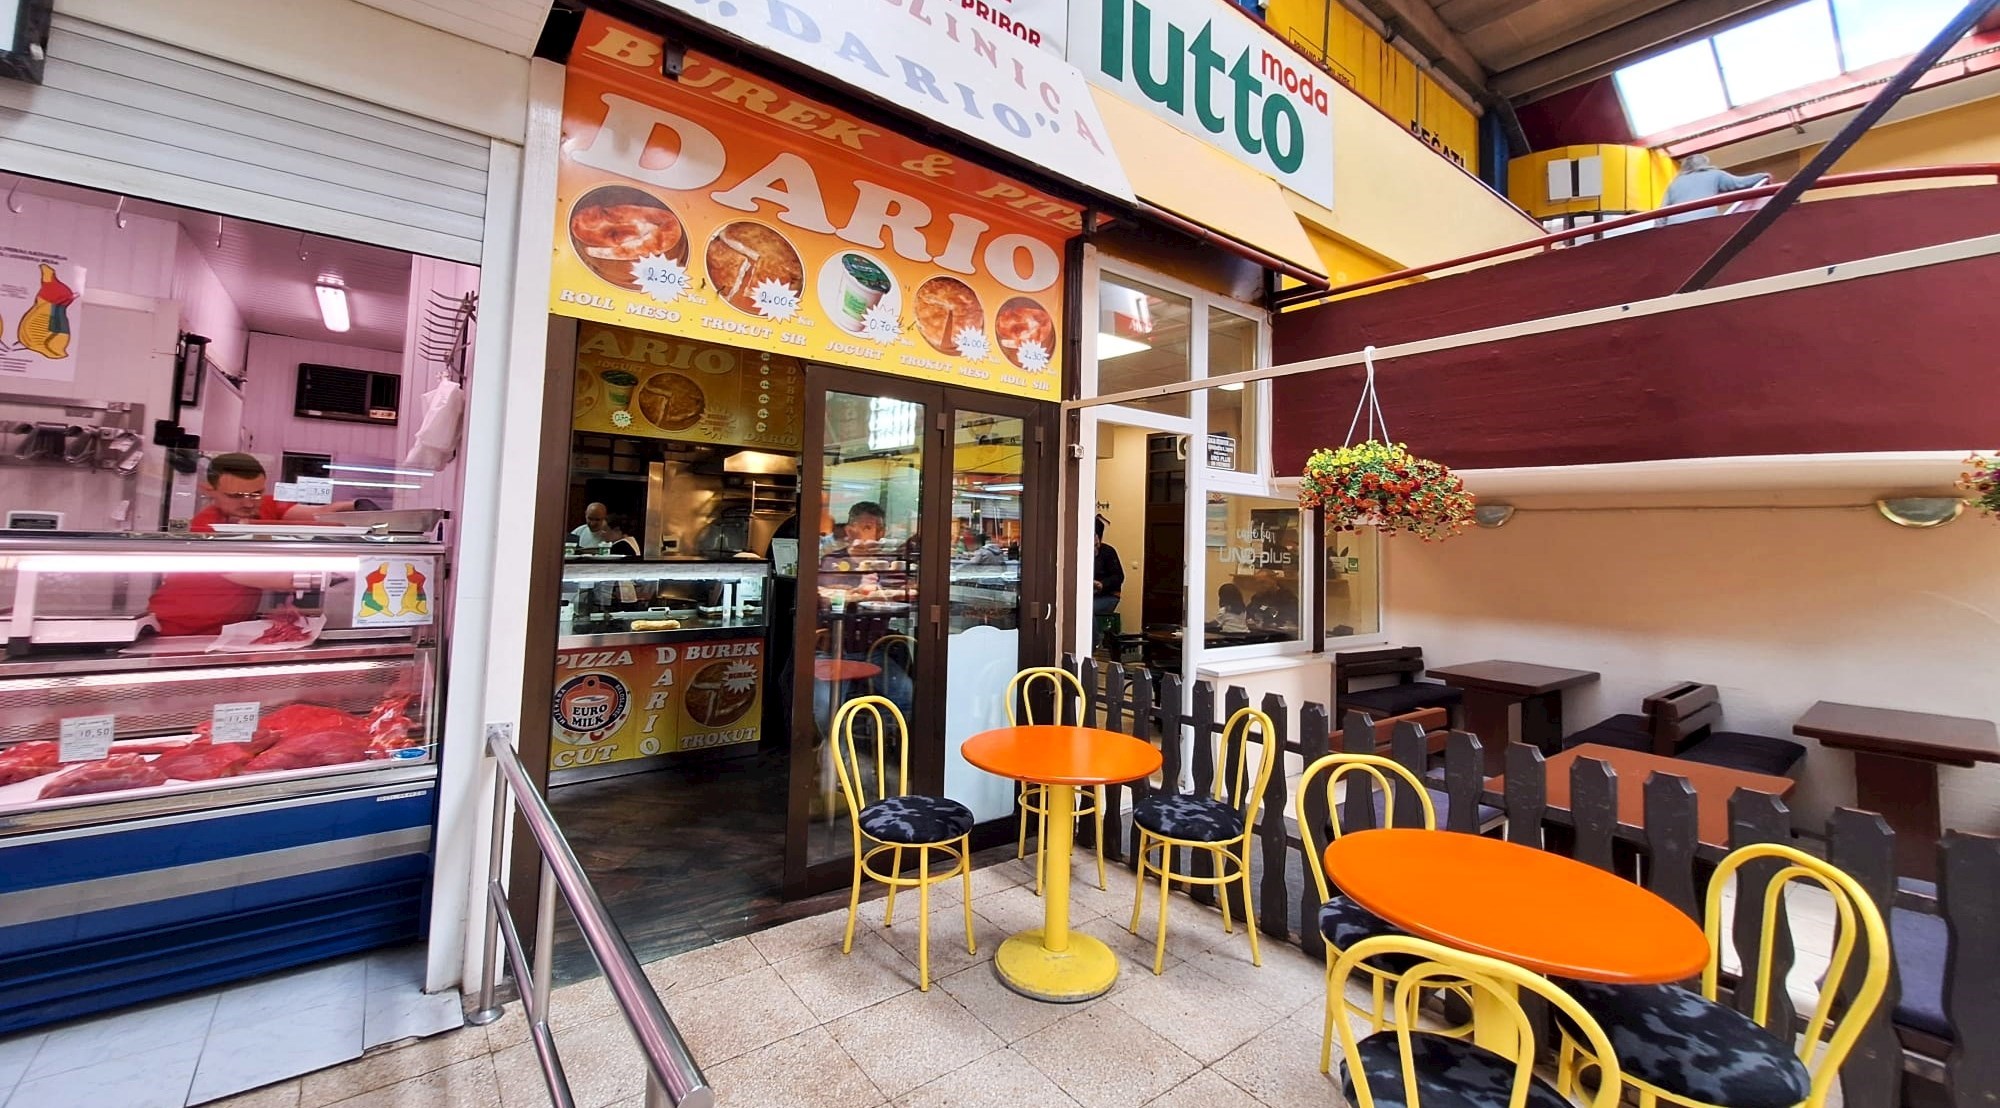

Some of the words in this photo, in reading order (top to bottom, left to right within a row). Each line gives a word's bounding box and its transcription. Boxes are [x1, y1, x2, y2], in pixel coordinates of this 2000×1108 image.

[1261, 49, 1328, 116] moda
[587, 26, 881, 150] BUREK
[901, 153, 956, 178] &
[570, 92, 1061, 293] DARIO
[647, 266, 685, 286] 2.30€
[559, 289, 616, 311] ROLL
[625, 302, 682, 323] MESO
[760, 291, 794, 308] 2.00€
[700, 316, 774, 339] TROKUT
[780, 332, 808, 346] SIR
[825, 341, 886, 361] JOGURT
[958, 366, 991, 381] MESO
[556, 651, 634, 669] PIZZA
[685, 643, 760, 660] BUREK
[573, 704, 608, 716] EURO
[640, 646, 677, 755] DARIO
[572, 715, 604, 727] MILK
[680, 728, 756, 749] TROKUT
[553, 745, 618, 767] CUT
